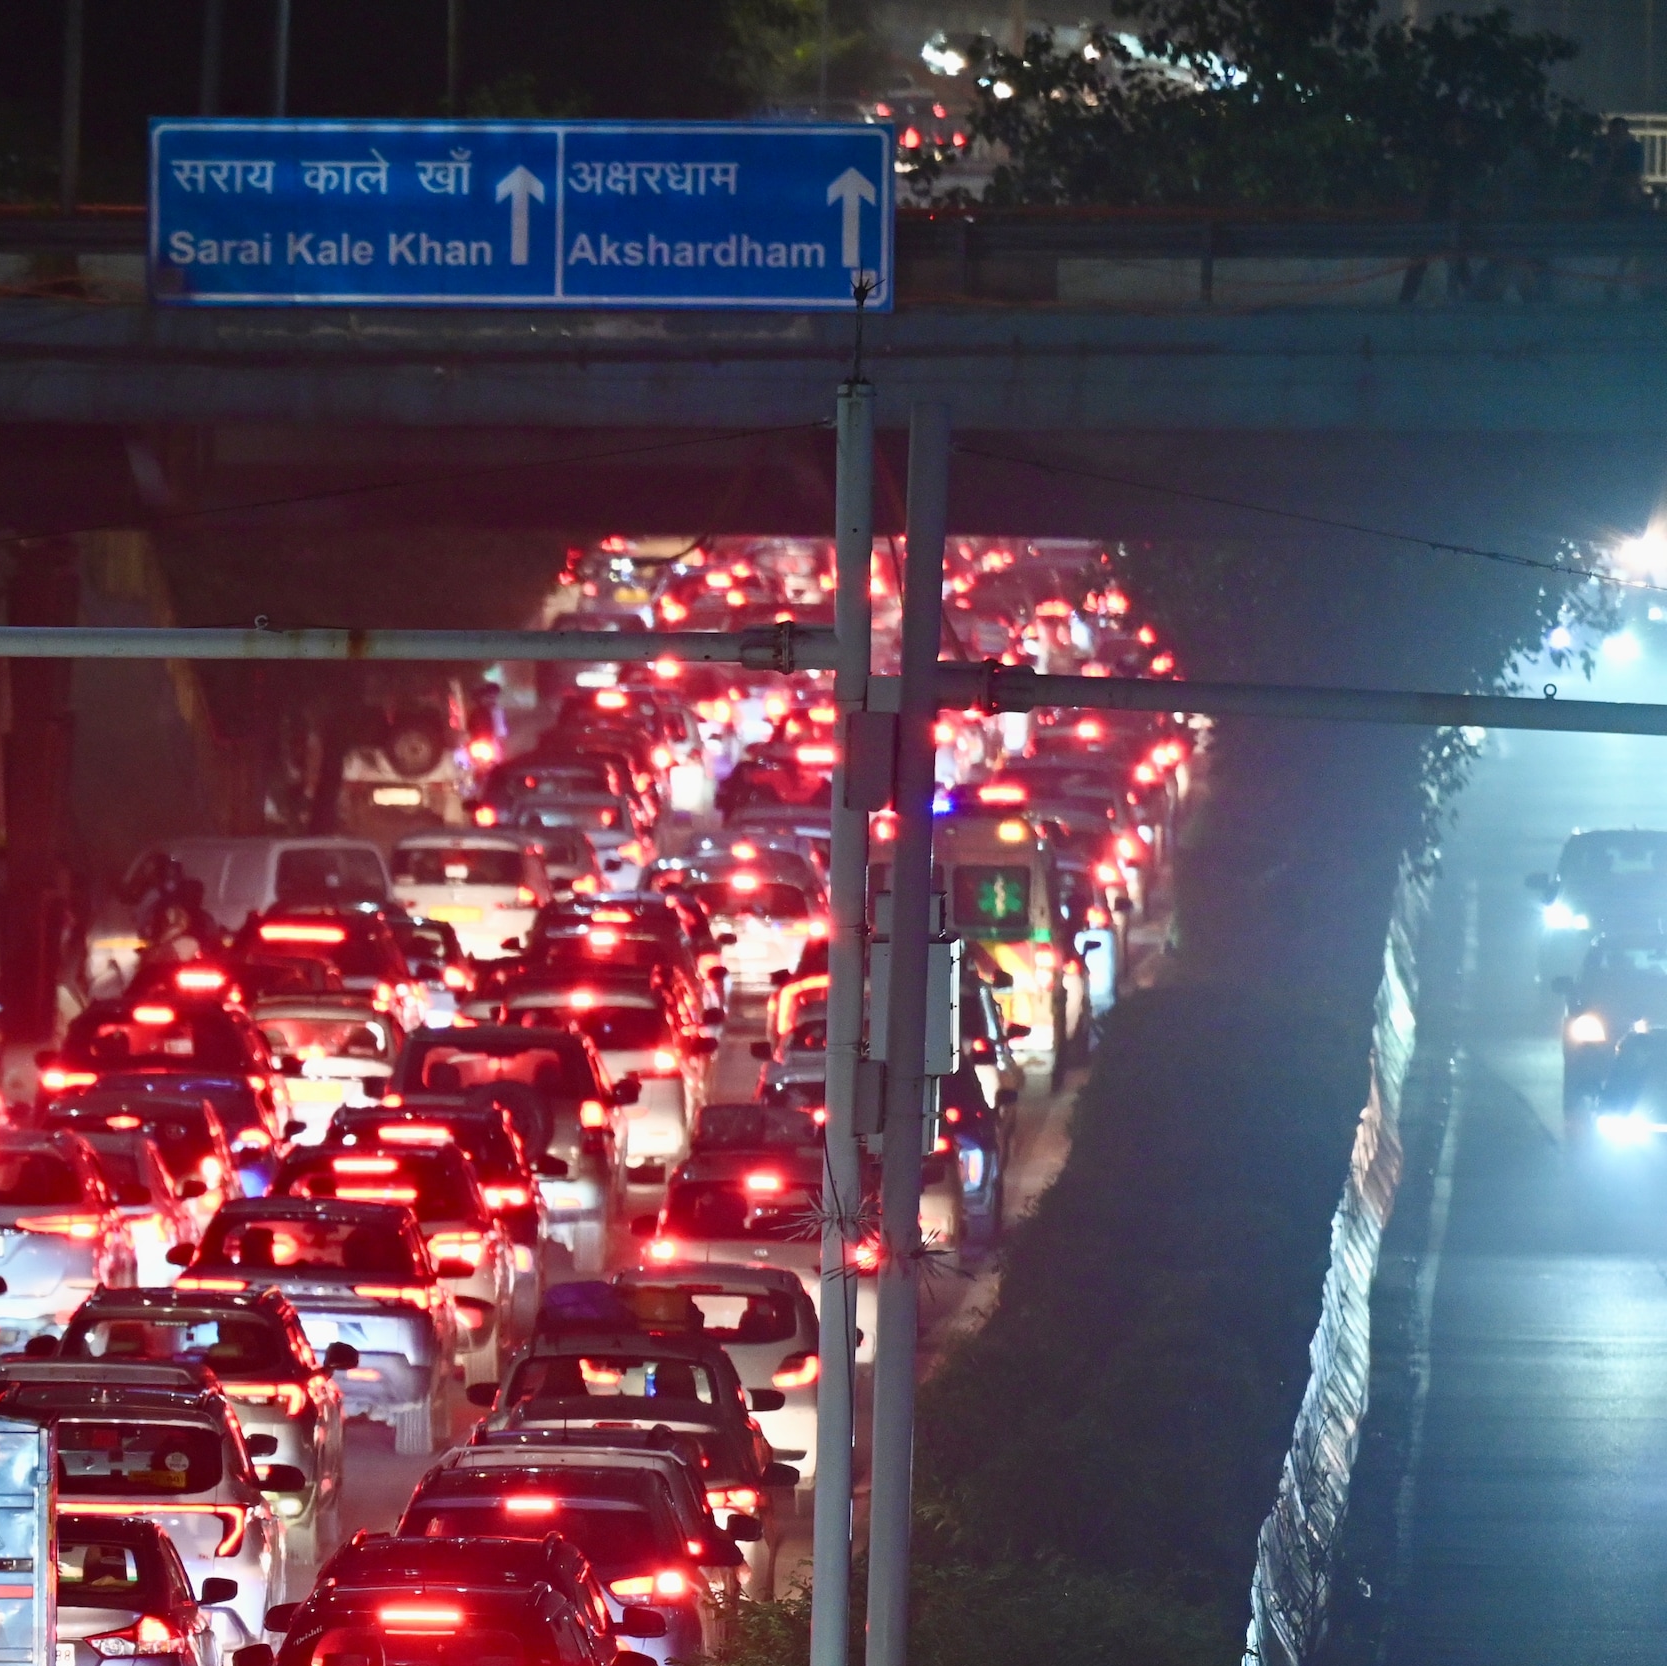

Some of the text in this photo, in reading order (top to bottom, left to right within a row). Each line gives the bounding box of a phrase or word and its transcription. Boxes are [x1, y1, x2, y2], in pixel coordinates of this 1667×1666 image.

[170, 158, 275, 194] सराय
[302, 148, 390, 195] काले
[567, 159, 739, 197] अक्षरधाम
[169, 231, 493, 269] Sarai Kale Khan
[568, 234, 826, 269] Akshardham
